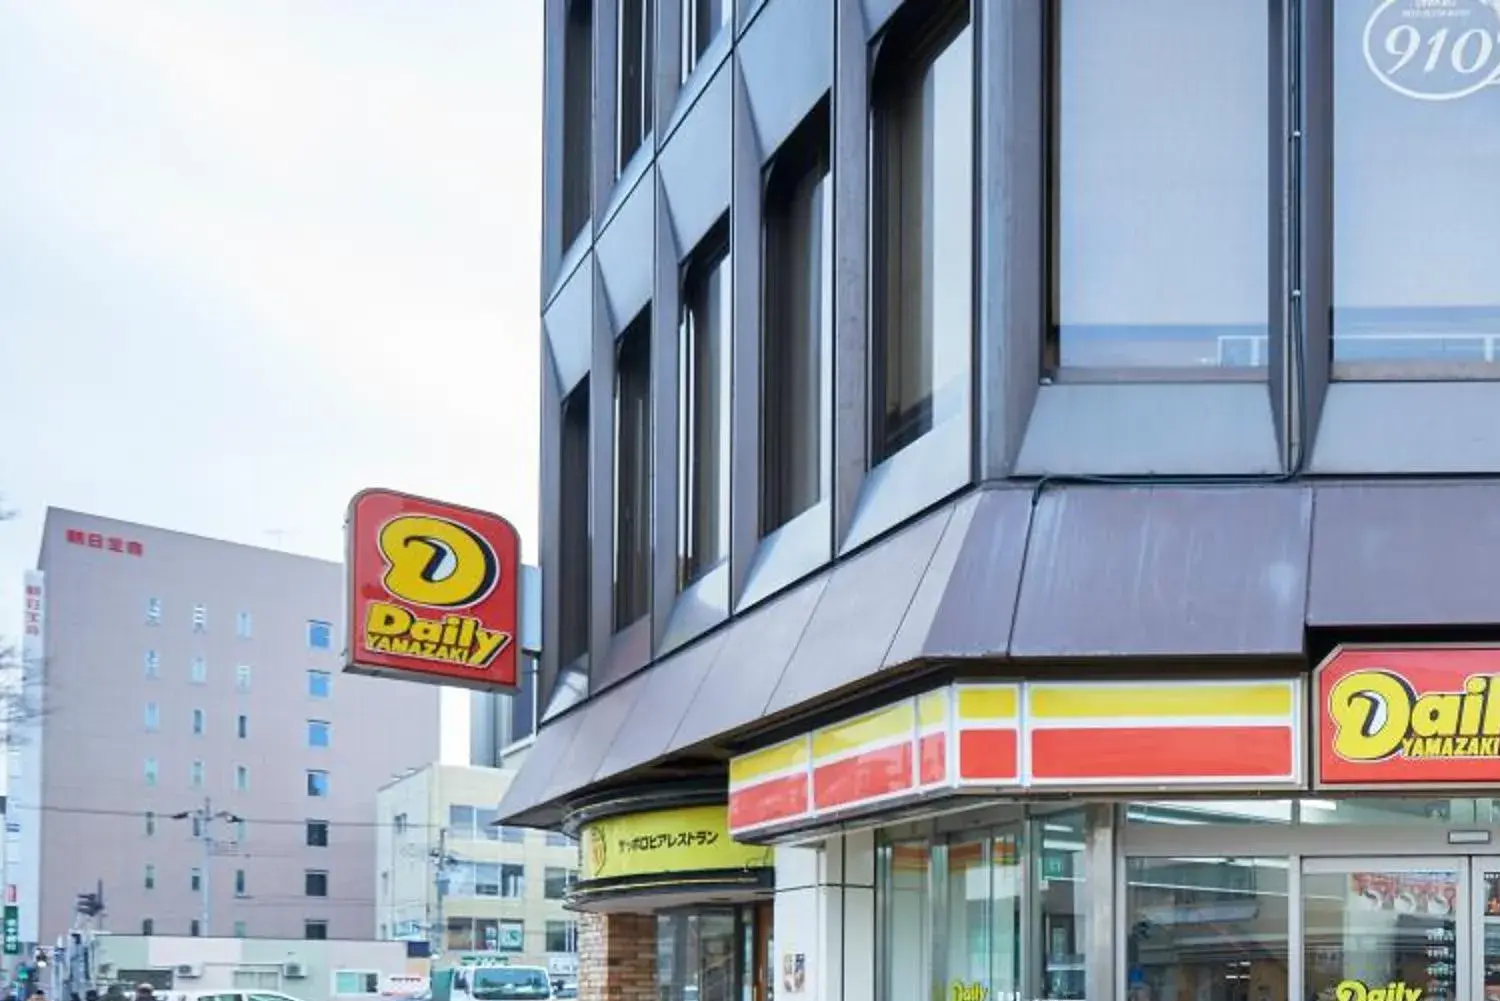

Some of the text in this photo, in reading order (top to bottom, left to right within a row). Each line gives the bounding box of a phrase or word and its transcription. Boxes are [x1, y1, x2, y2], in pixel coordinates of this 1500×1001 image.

[1385, 25, 1493, 75] 910
[366, 601, 507, 667] Daily
[366, 633, 468, 663] YAMAZAKI
[1402, 736, 1500, 758] YAMAZAKI
